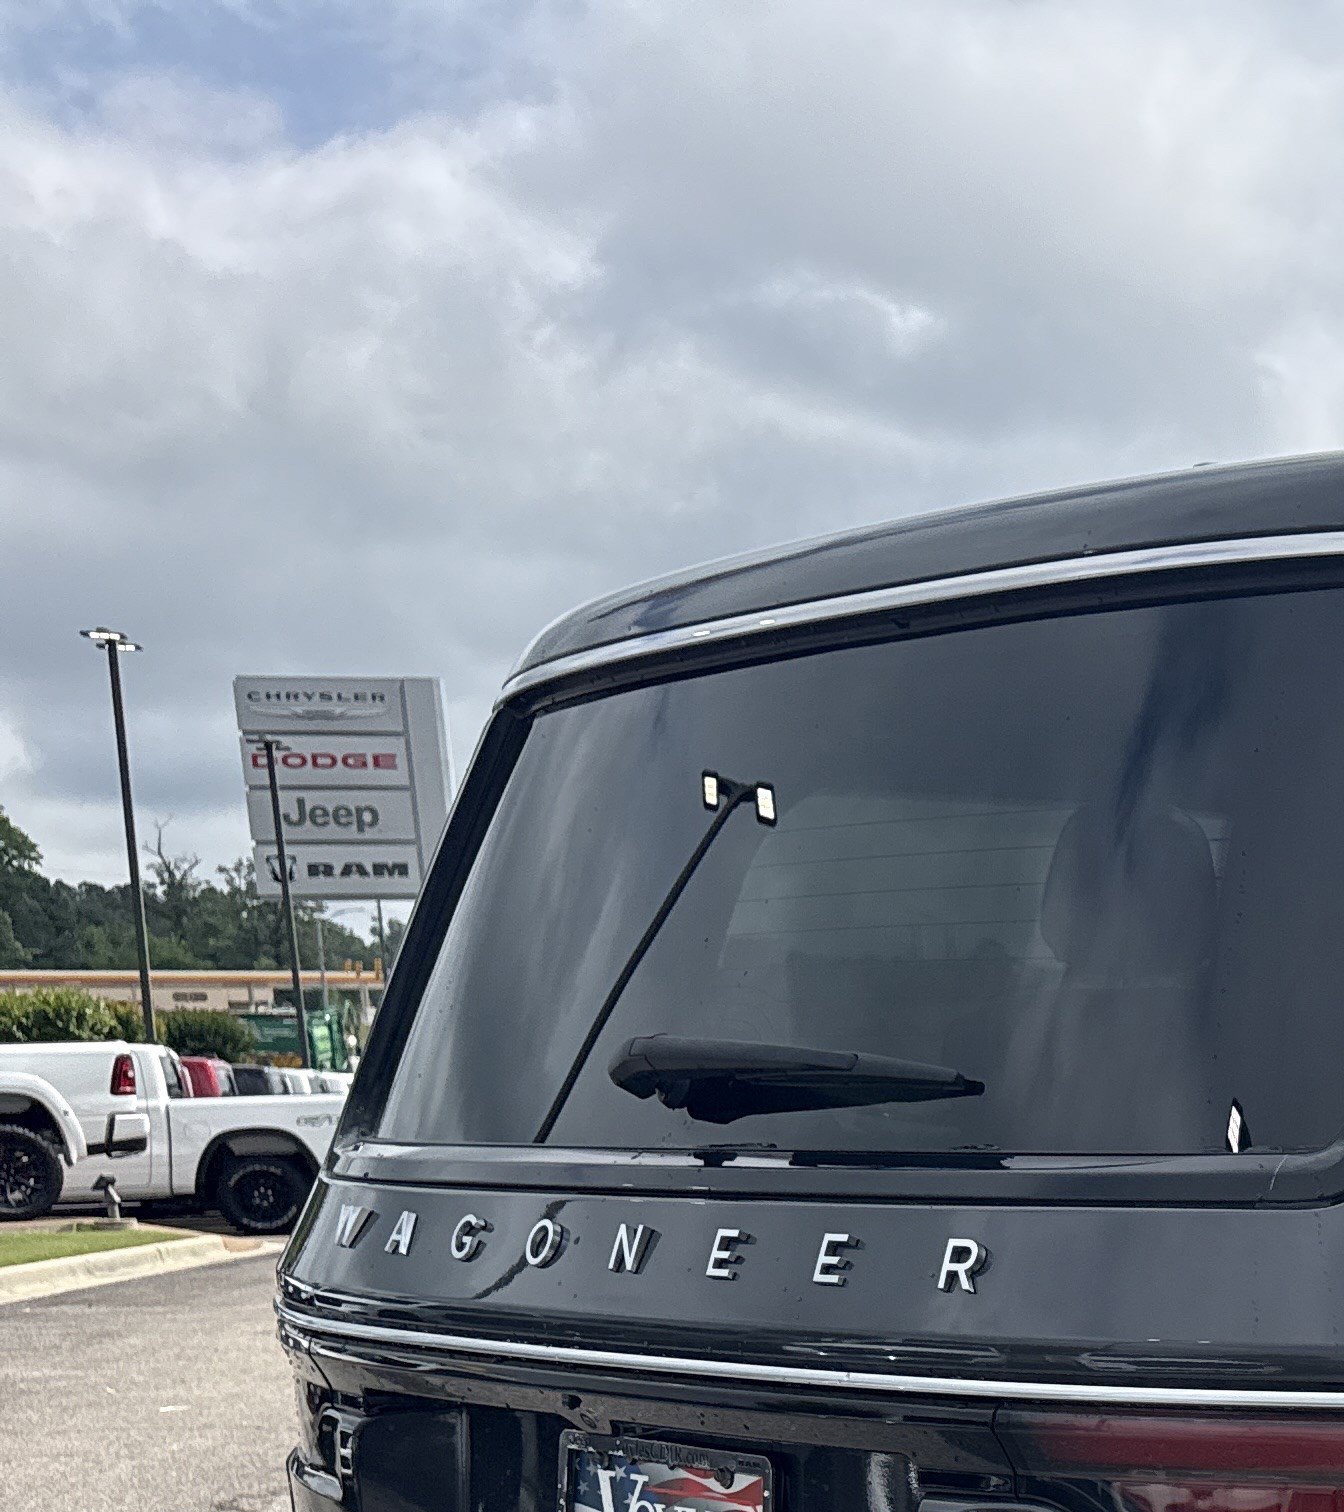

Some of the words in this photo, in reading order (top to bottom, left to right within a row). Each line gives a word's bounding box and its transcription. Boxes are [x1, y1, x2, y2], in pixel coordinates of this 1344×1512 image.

[246, 690, 386, 704] CHRYSLER
[251, 752, 398, 770] DODGE
[282, 796, 380, 833] Jeep
[306, 861, 409, 879] RAM
[334, 1204, 992, 1294] WAGONEER
